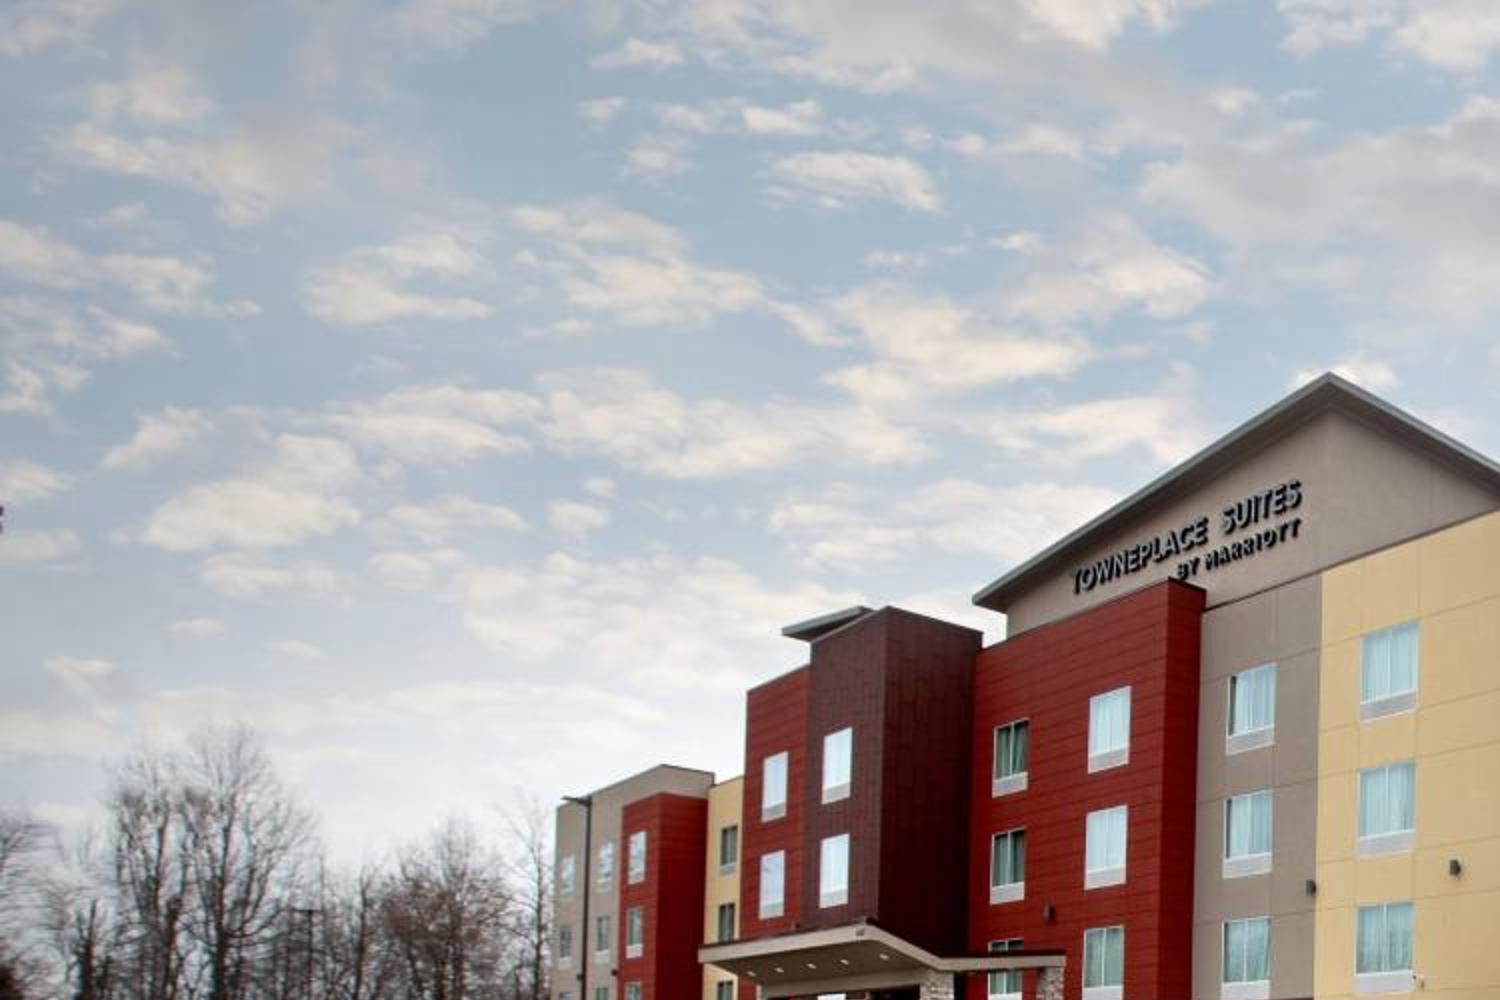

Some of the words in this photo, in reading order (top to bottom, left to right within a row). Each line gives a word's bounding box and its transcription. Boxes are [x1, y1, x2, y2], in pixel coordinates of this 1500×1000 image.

[1073, 516, 1209, 594] TOWNEPLACE
[1222, 480, 1303, 535] SUITES
[1176, 557, 1200, 580] BY
[1205, 518, 1302, 571] MARRIOTT
